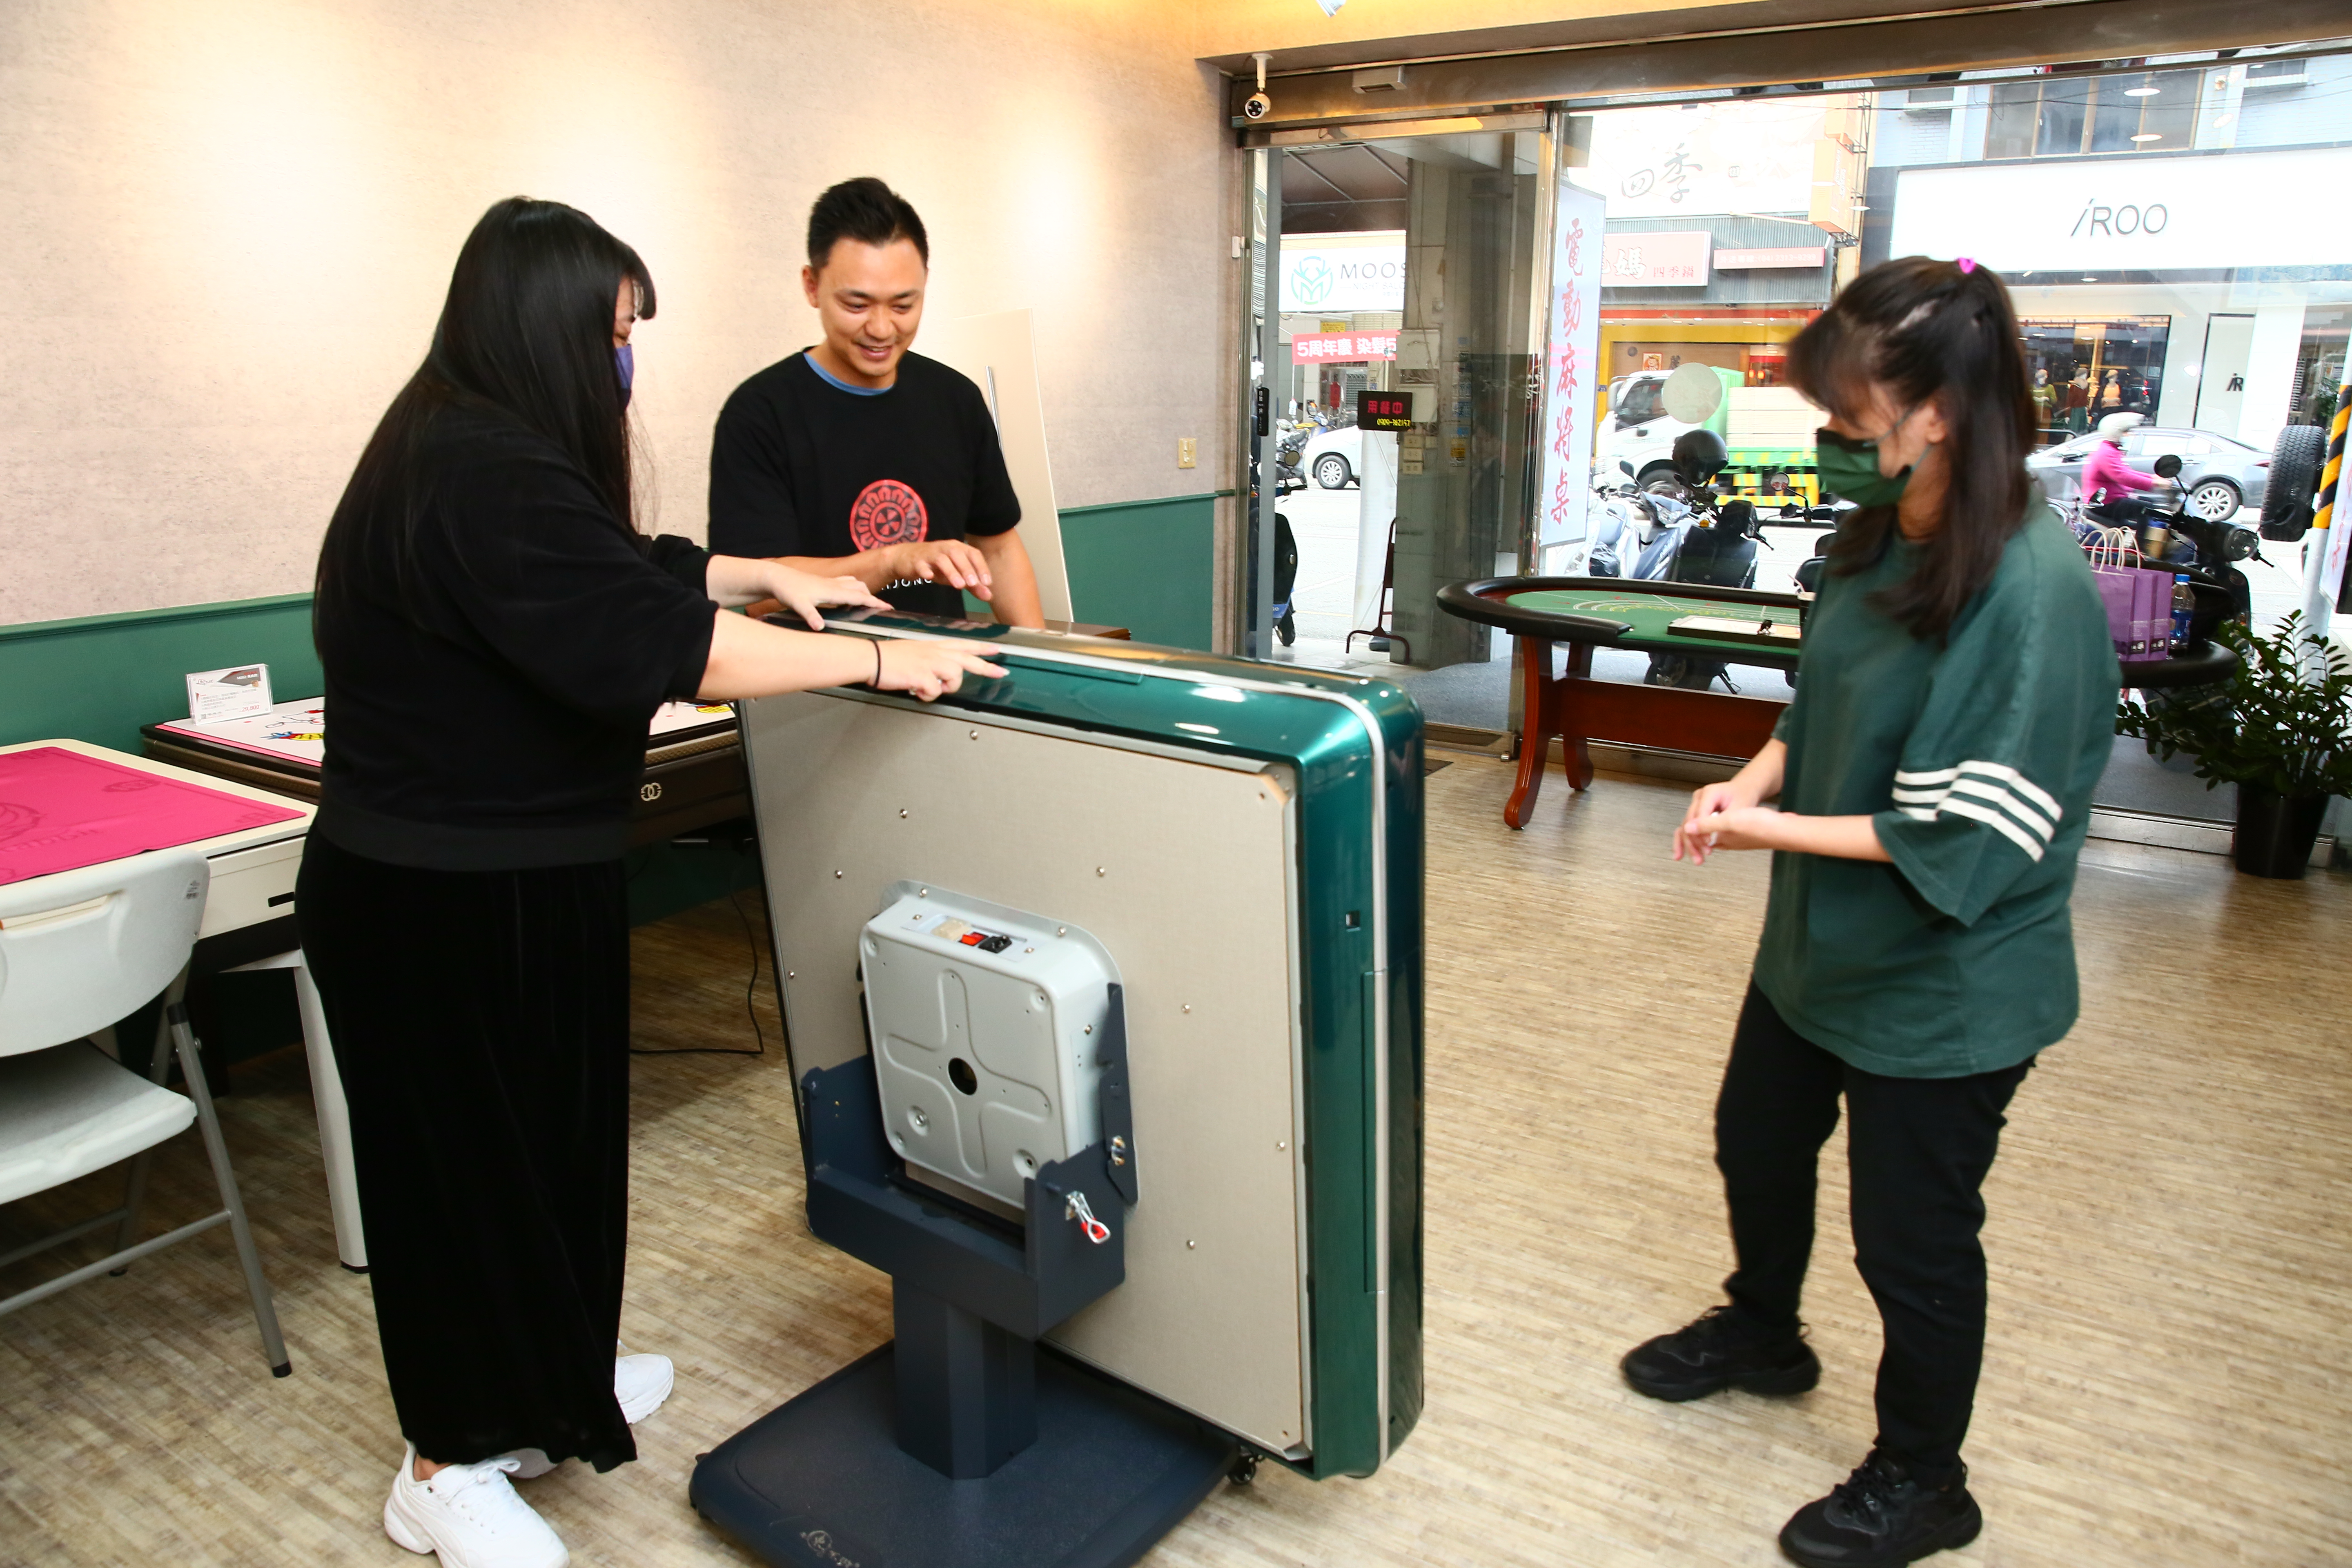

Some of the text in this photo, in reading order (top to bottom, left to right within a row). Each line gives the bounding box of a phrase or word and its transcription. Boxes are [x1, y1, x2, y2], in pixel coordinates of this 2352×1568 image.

[1297, 337, 1353, 357] 5周年慶
[1550, 218, 1584, 525] 電動麻將桌
